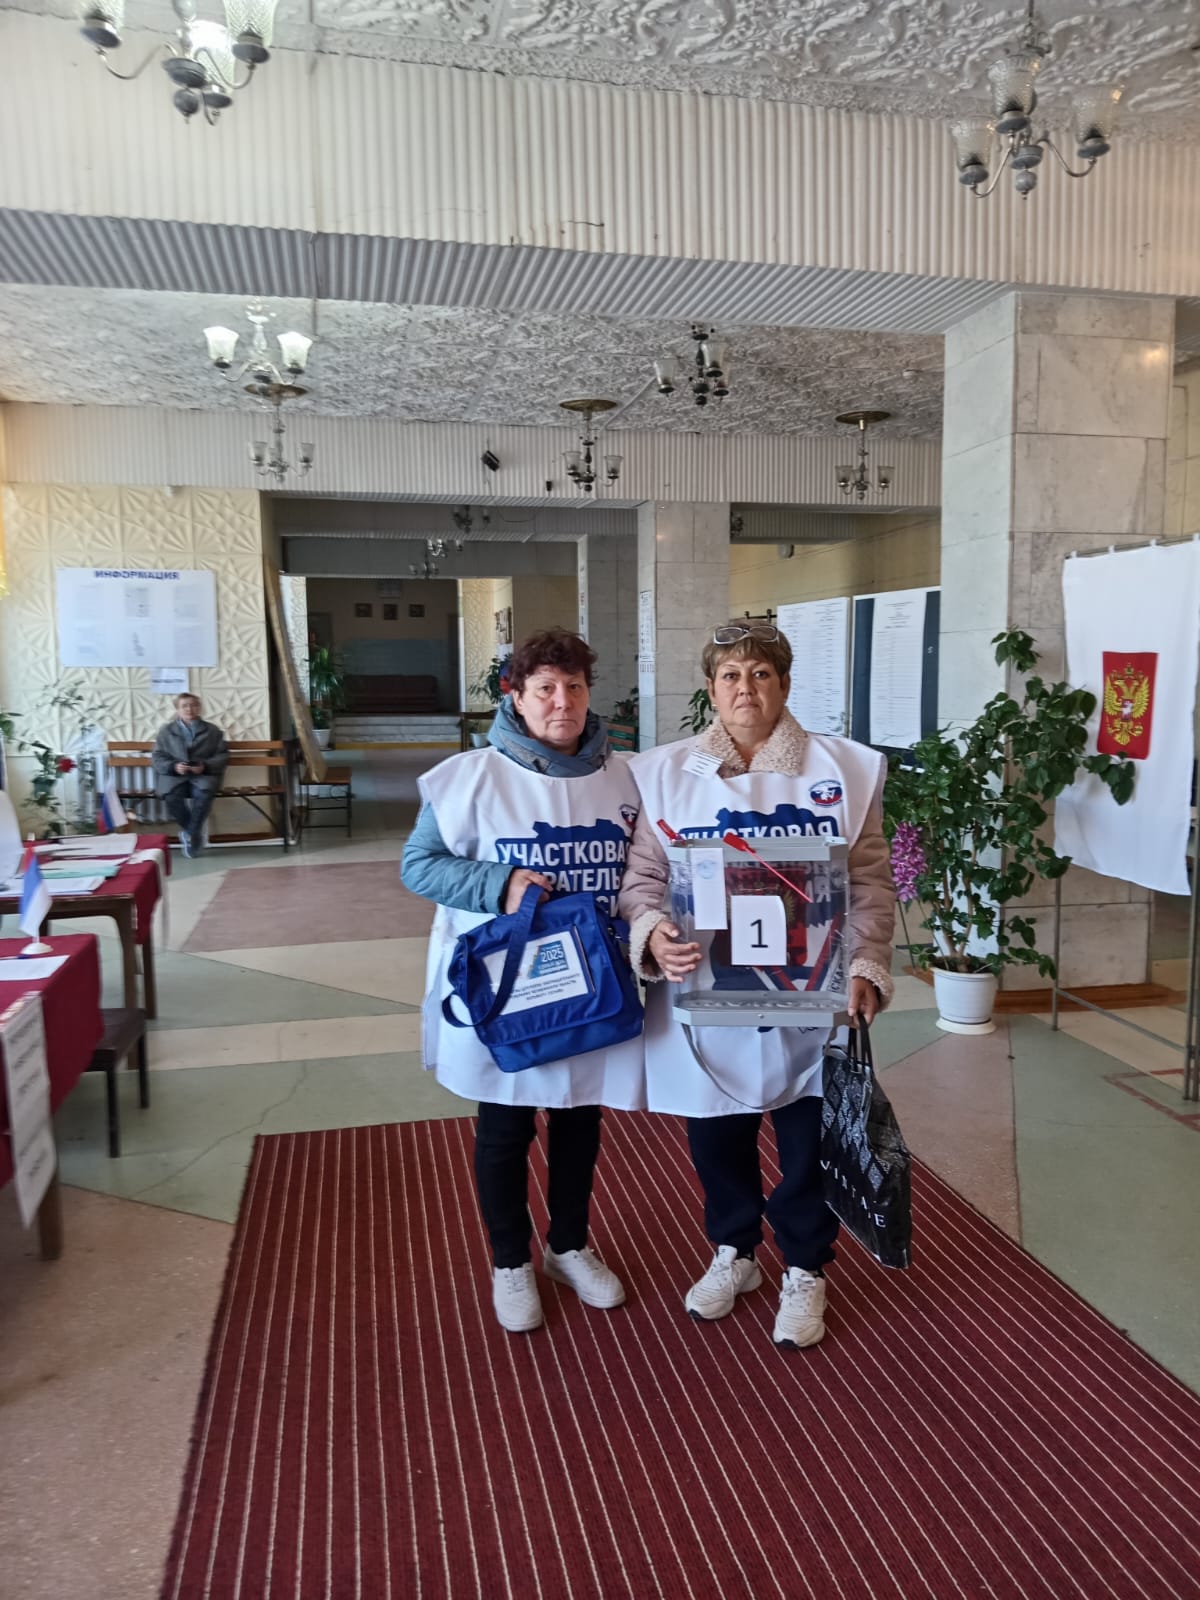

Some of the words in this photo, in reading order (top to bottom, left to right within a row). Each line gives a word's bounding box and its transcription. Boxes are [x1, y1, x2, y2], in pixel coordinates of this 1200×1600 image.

[94, 570, 180, 580] ИНФОРМАЦИЯ
[497, 840, 630, 867] УЧАСТКОВА
[750, 919, 769, 948] 1
[540, 948, 564, 963] 2025
